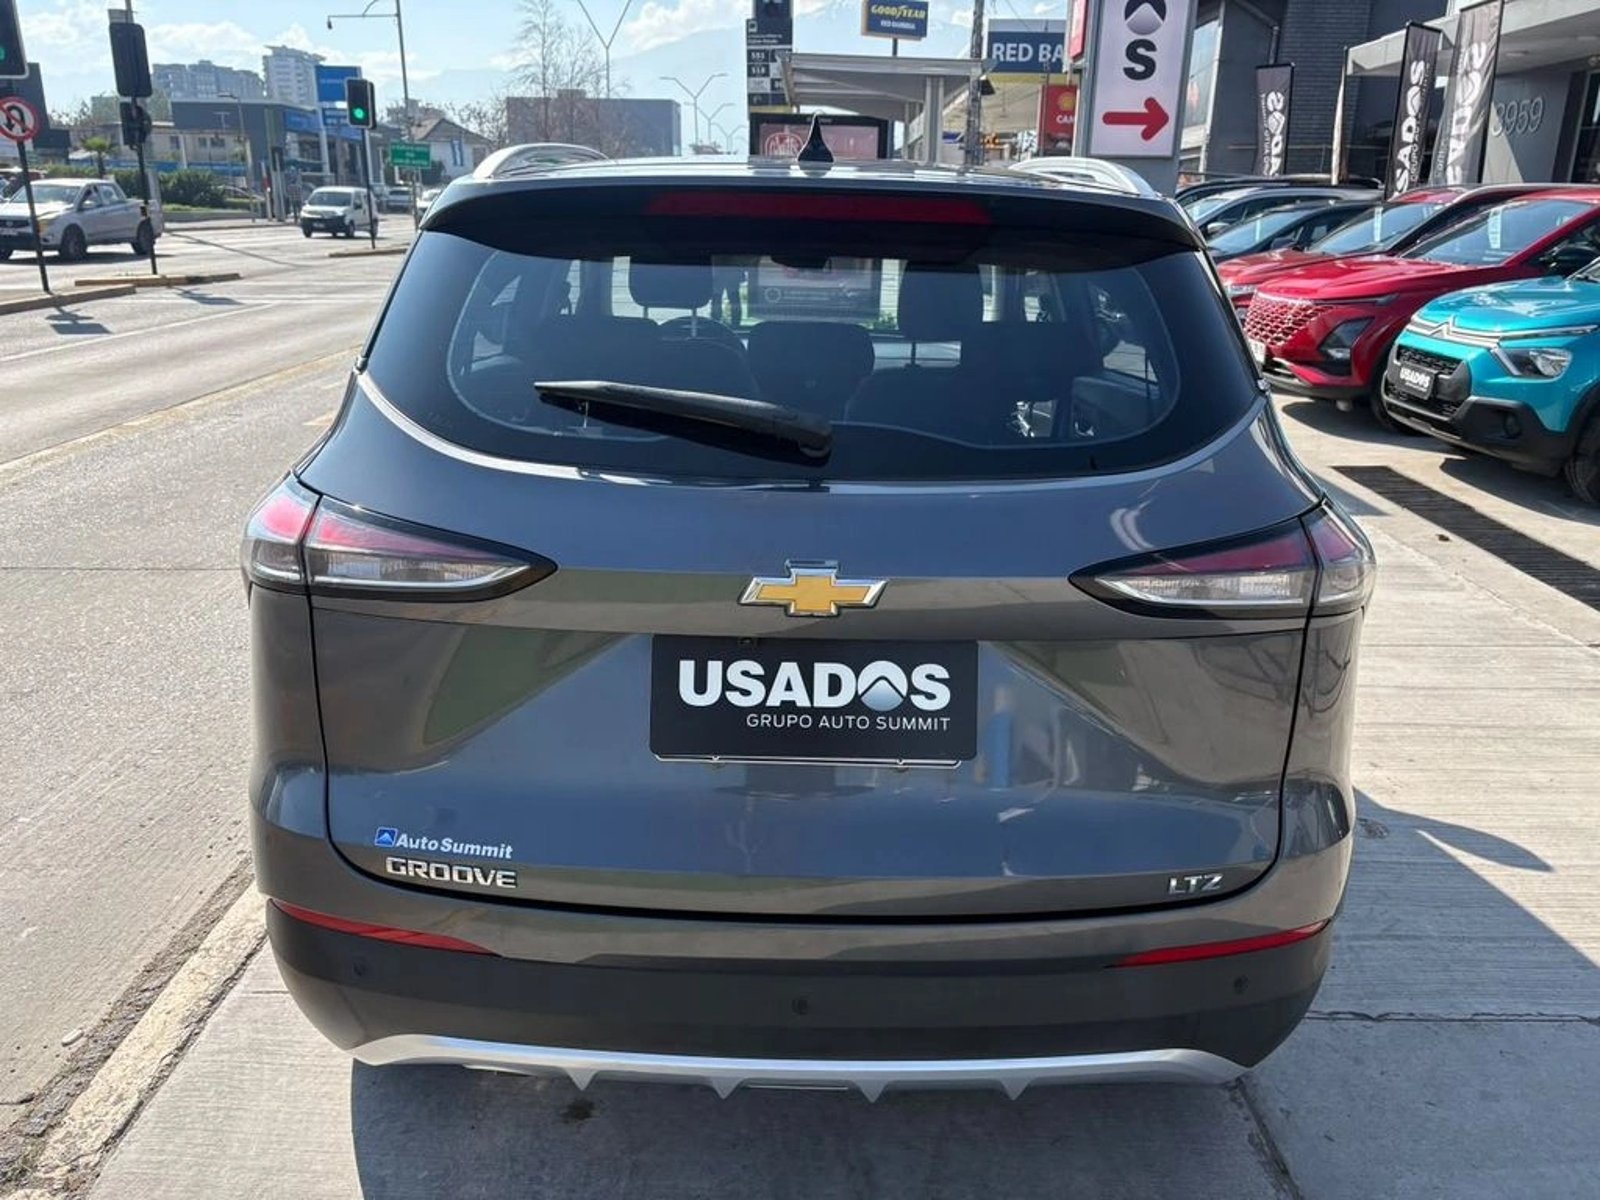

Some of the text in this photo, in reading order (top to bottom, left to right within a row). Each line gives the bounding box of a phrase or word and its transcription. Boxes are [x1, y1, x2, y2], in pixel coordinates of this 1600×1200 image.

[871, 4, 926, 20] GOODYEAR
[991, 42, 1034, 62] RED
[1387, 60, 1426, 201] SADOS
[679, 659, 951, 711] USADOS
[746, 713, 951, 732] GRUPO AUTO SUMMIT
[385, 856, 517, 889] GROOVE
[1168, 873, 1224, 895] LTZ
